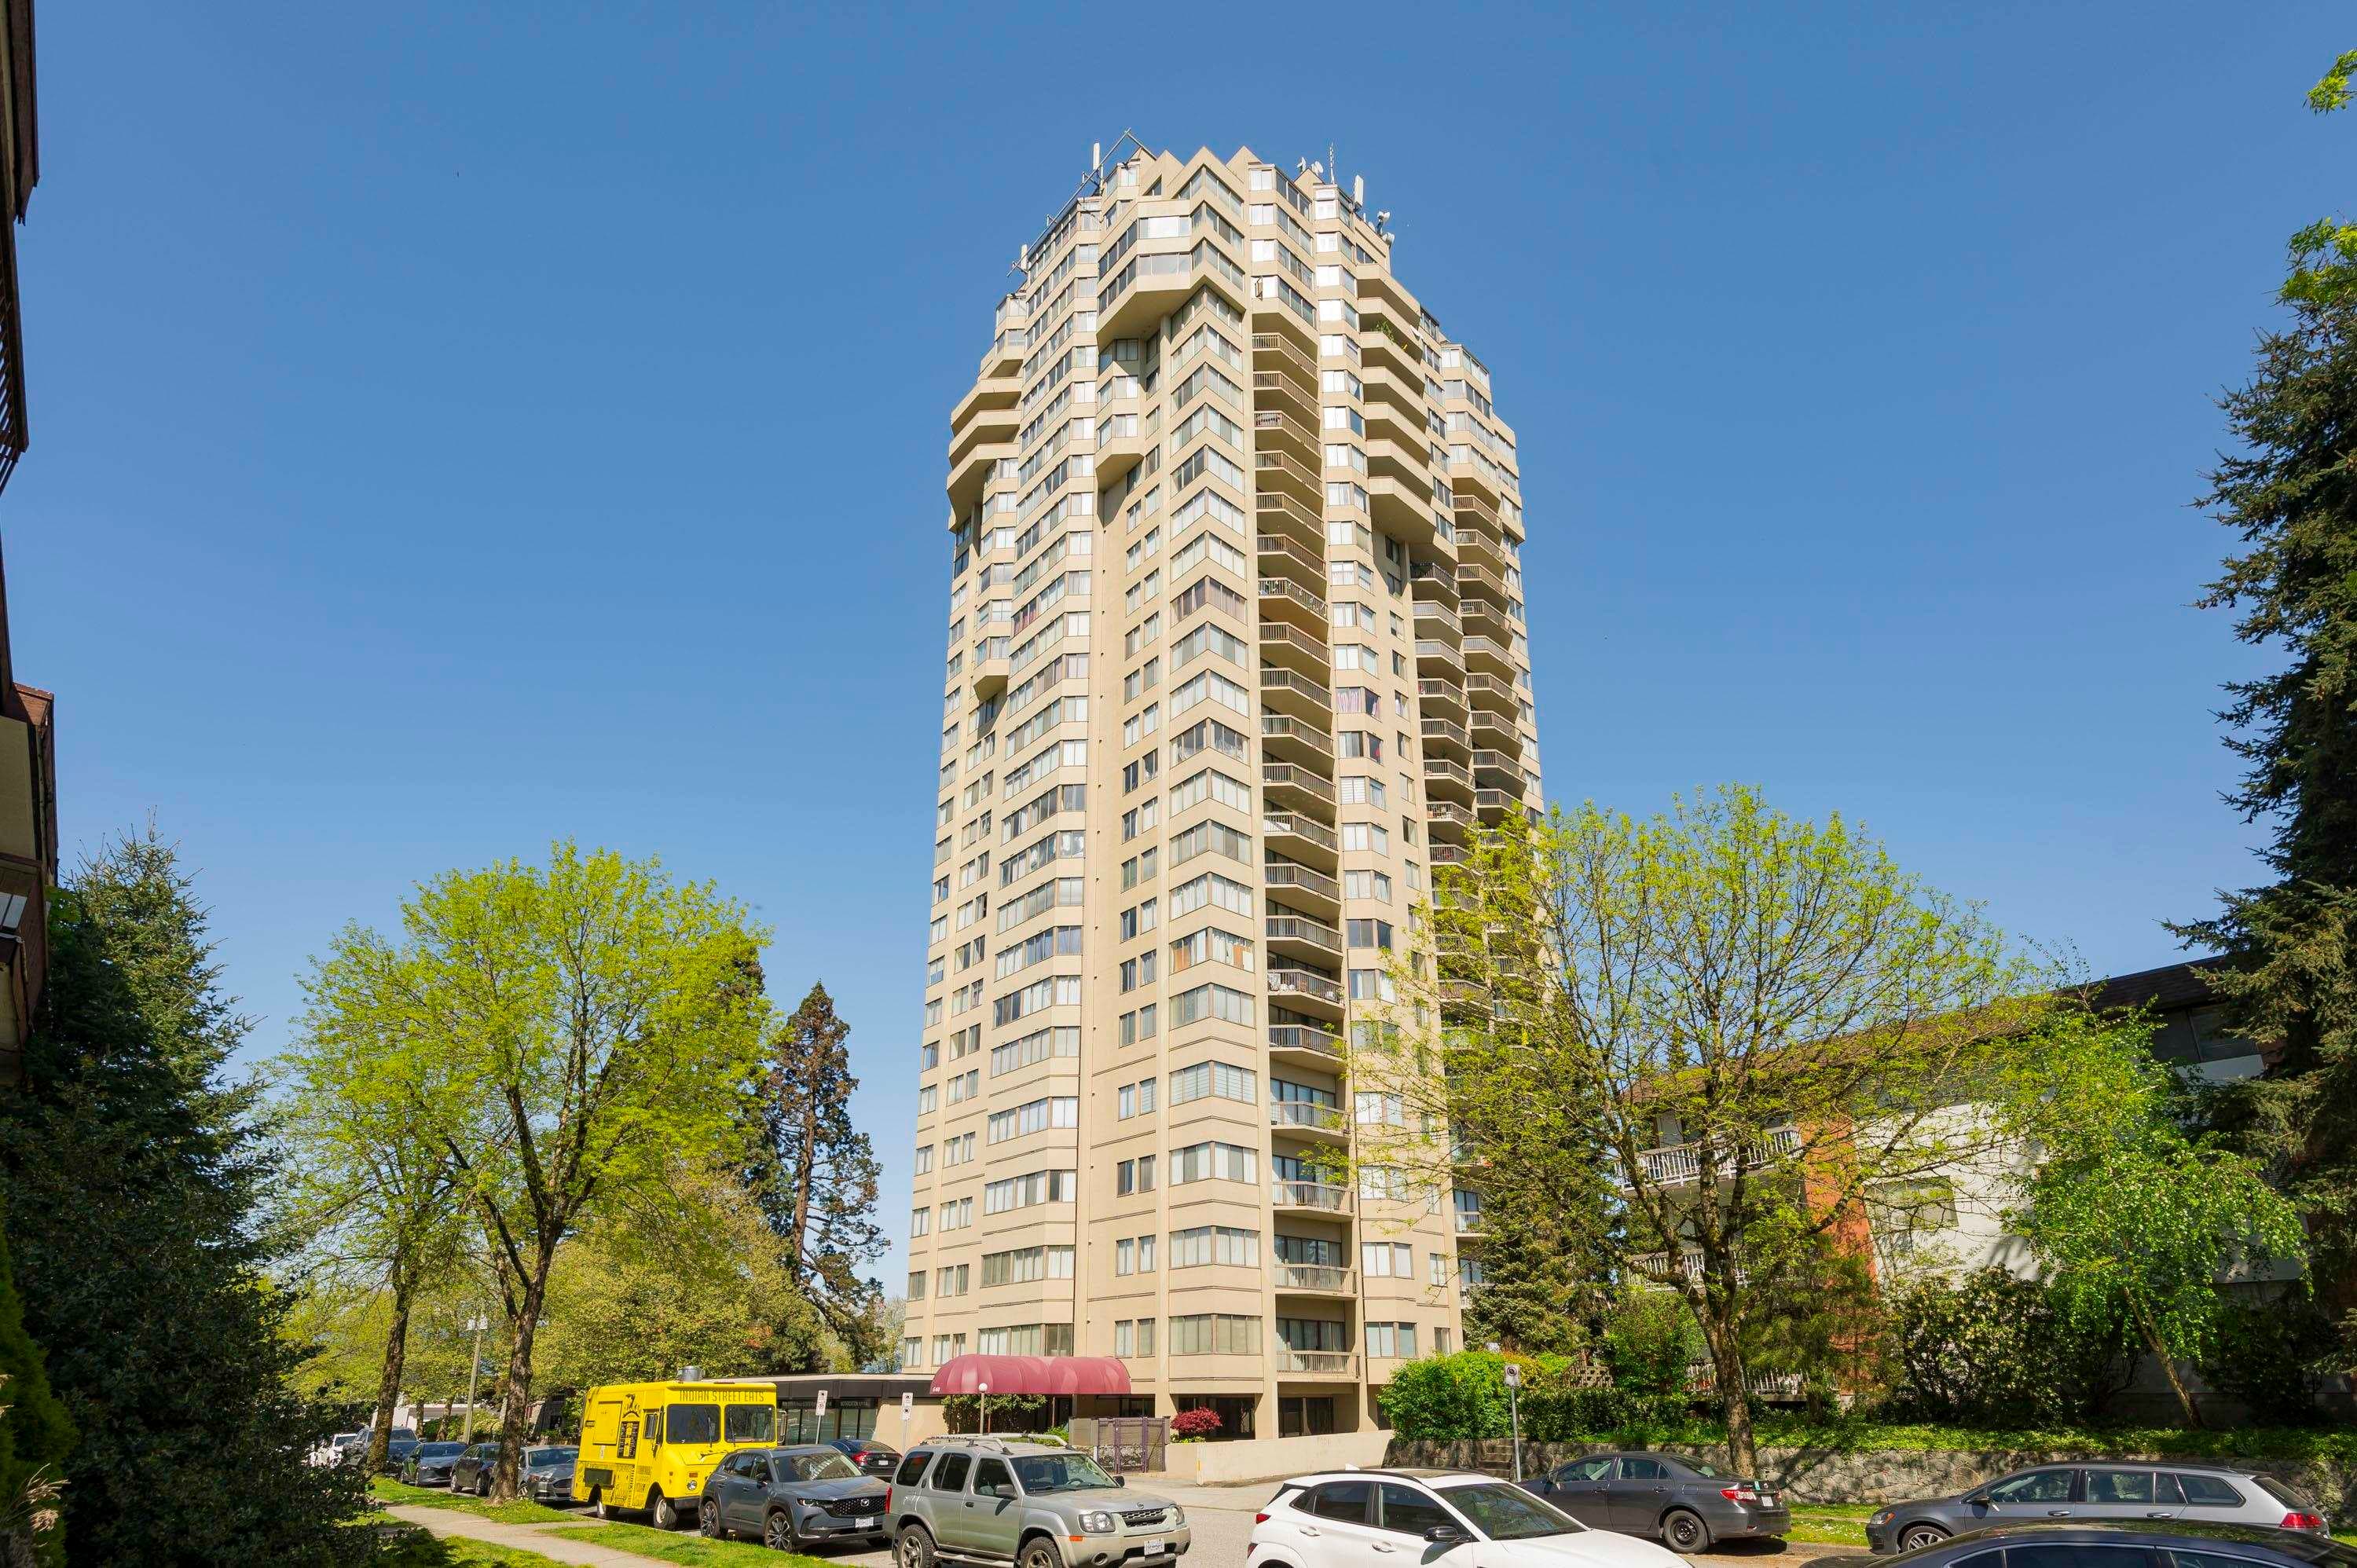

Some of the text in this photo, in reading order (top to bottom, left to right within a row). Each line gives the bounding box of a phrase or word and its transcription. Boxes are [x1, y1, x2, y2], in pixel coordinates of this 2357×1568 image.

[680, 1390, 764, 1402] INDIAN STREET EATS
